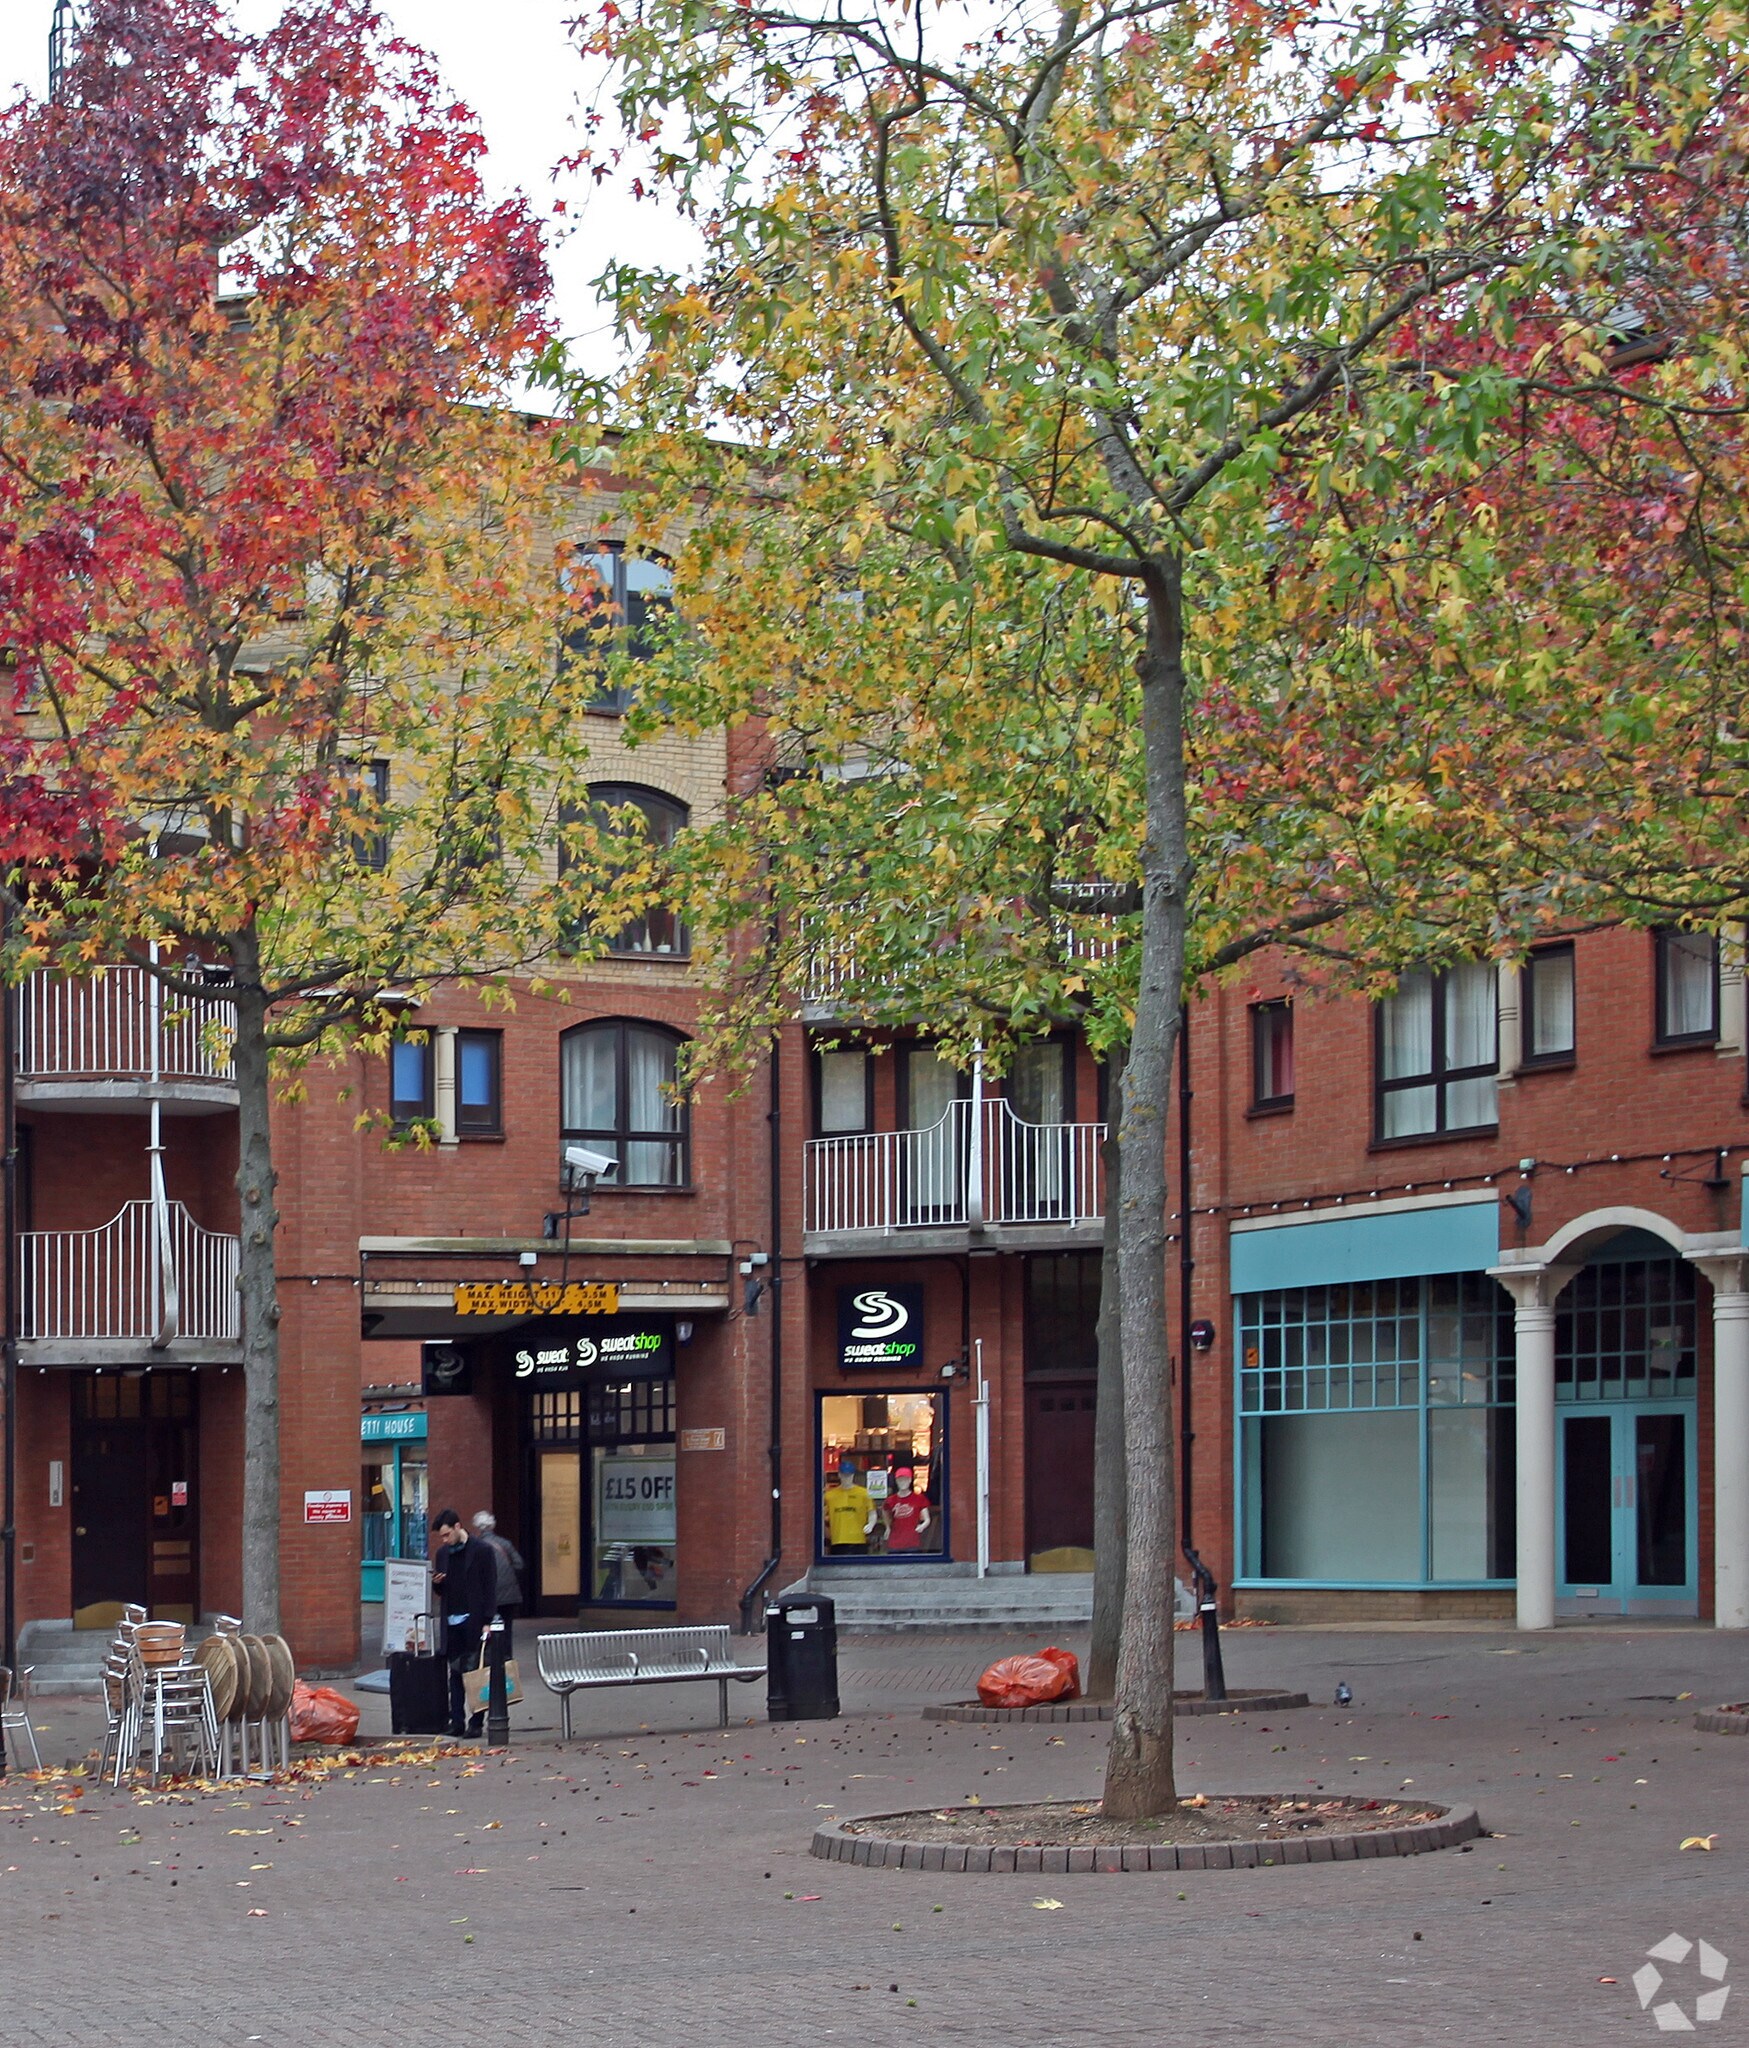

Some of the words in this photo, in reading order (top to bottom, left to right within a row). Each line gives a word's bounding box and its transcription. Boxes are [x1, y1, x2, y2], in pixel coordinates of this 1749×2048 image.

[467, 1291, 494, 1299] MAX.
[499, 1291, 540, 1299] HEIGHT
[582, 1291, 607, 1299] 3.5M
[500, 1300, 536, 1308] WIDTH
[576, 1300, 602, 1308] 4.5M
[600, 1332, 662, 1353] sweatshop
[843, 1341, 917, 1357] sweatshop
[384, 1417, 416, 1435] HOUSE
[605, 1477, 637, 1500] £15
[641, 1475, 673, 1500] OFF
